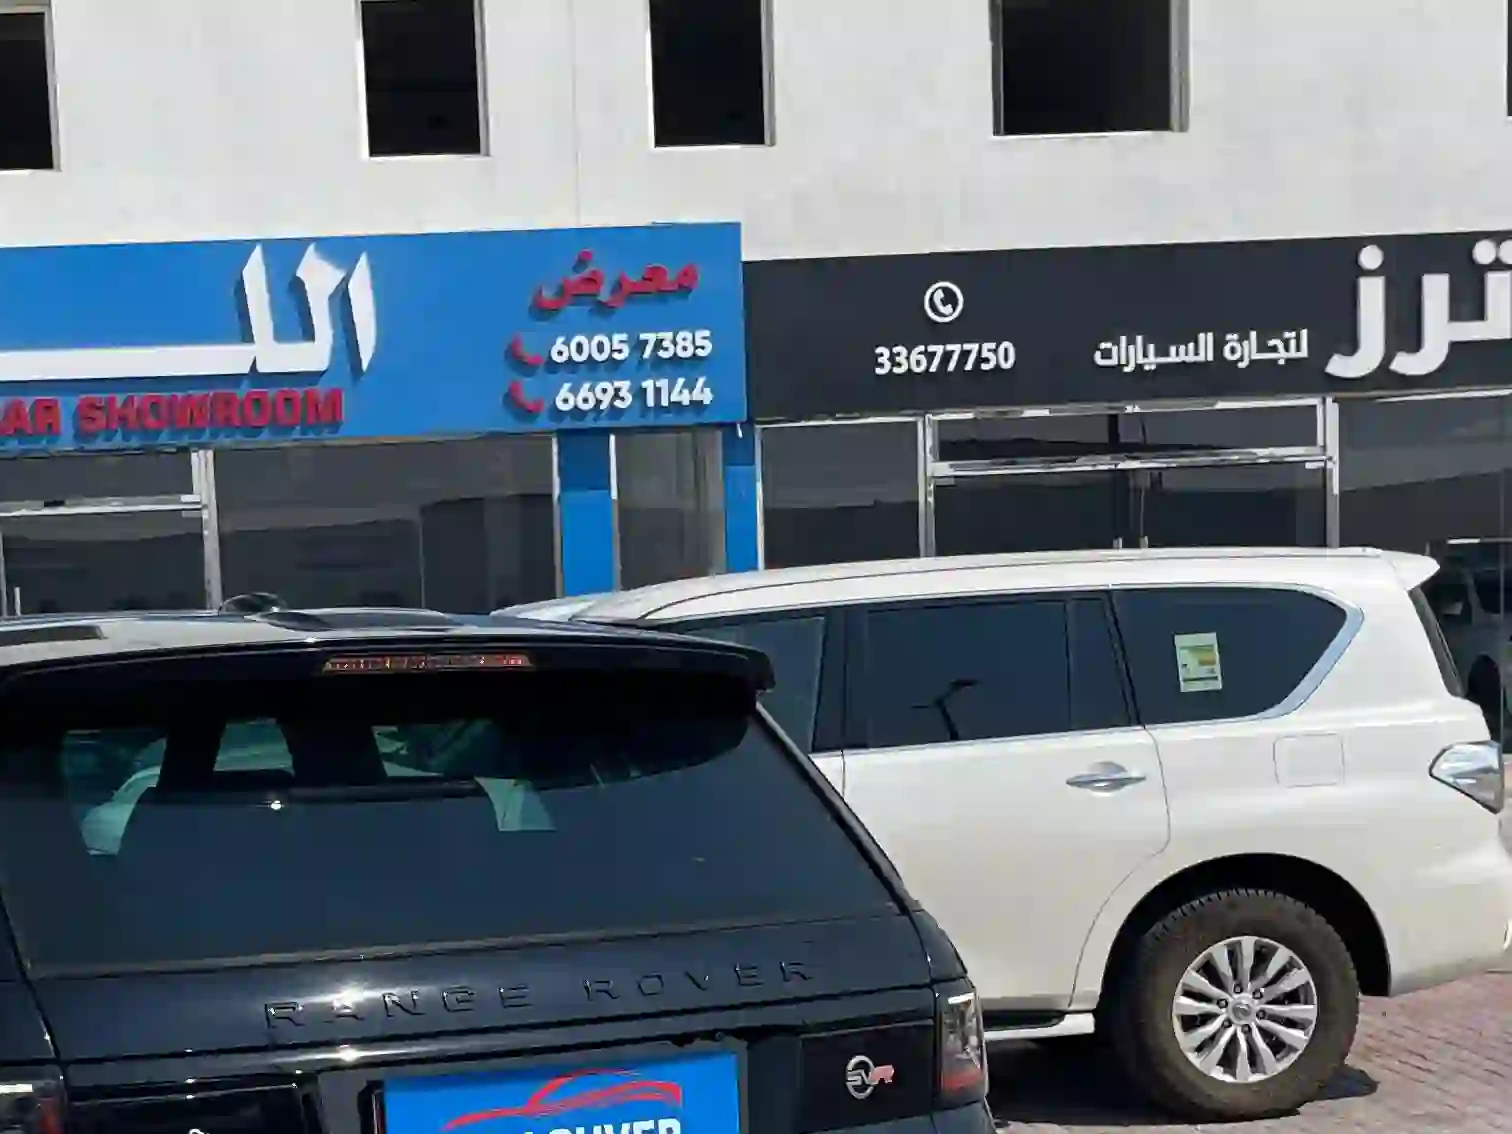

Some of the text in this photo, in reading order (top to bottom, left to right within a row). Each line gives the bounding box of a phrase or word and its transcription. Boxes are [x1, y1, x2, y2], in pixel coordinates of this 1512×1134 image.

[531, 248, 701, 310] معرض
[550, 329, 713, 363] 6005 7385
[873, 340, 1016, 376] 33677750
[1093, 328, 1309, 373] لتجارة السيارات
[76, 388, 345, 434] SHOWROOM
[554, 376, 714, 411] 6693 1144
[263, 960, 816, 1030] RANGE ROVER
